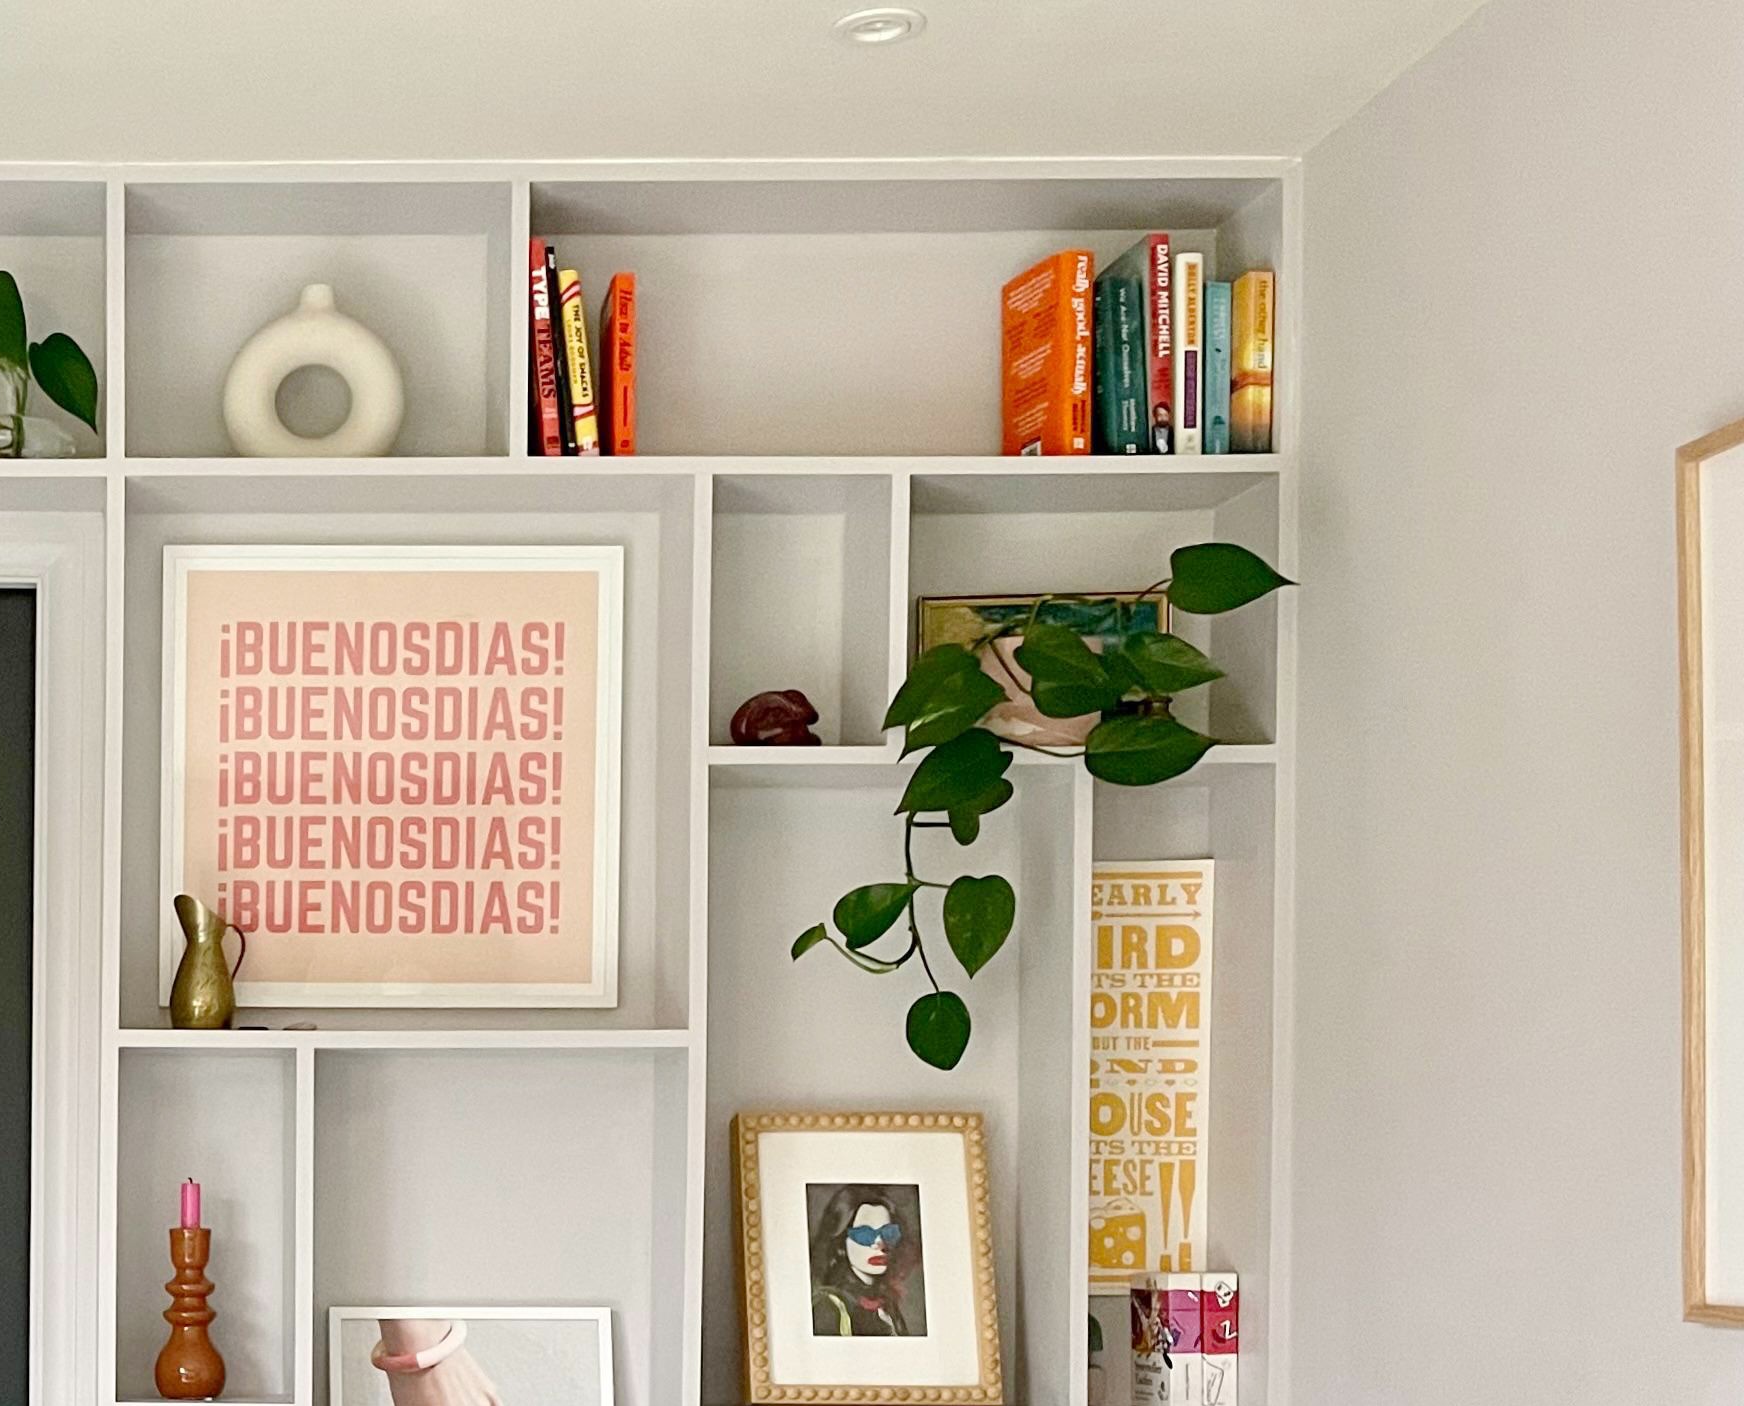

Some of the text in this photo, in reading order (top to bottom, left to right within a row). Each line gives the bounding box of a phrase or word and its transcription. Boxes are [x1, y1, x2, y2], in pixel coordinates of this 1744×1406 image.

[1071, 255, 1090, 293] really
[1157, 243, 1169, 288] DAVID
[1258, 280, 1269, 300] the
[531, 265, 557, 400] TYPE TEAMS
[573, 304, 581, 323] THE
[1158, 290, 1171, 359] MITCHELL
[575, 325, 584, 344] JOY
[1257, 338, 1269, 370] hand
[220, 621, 566, 678] ¡BUENOSDIAS!
[218, 686, 564, 743] ¡BUENOSDIAS!
[218, 751, 563, 807] ¡BUENOSDIAS!
[217, 815, 561, 871] ¡BUENOSDIAS!
[1096, 924, 1201, 970] IRD
[1092, 972, 1200, 988] TS THE
[1090, 991, 1200, 1029] ORM
[1092, 1036, 1151, 1051] BUT THE
[1089, 1091, 1198, 1137] OUSE
[1090, 1139, 1197, 1156] TS THE
